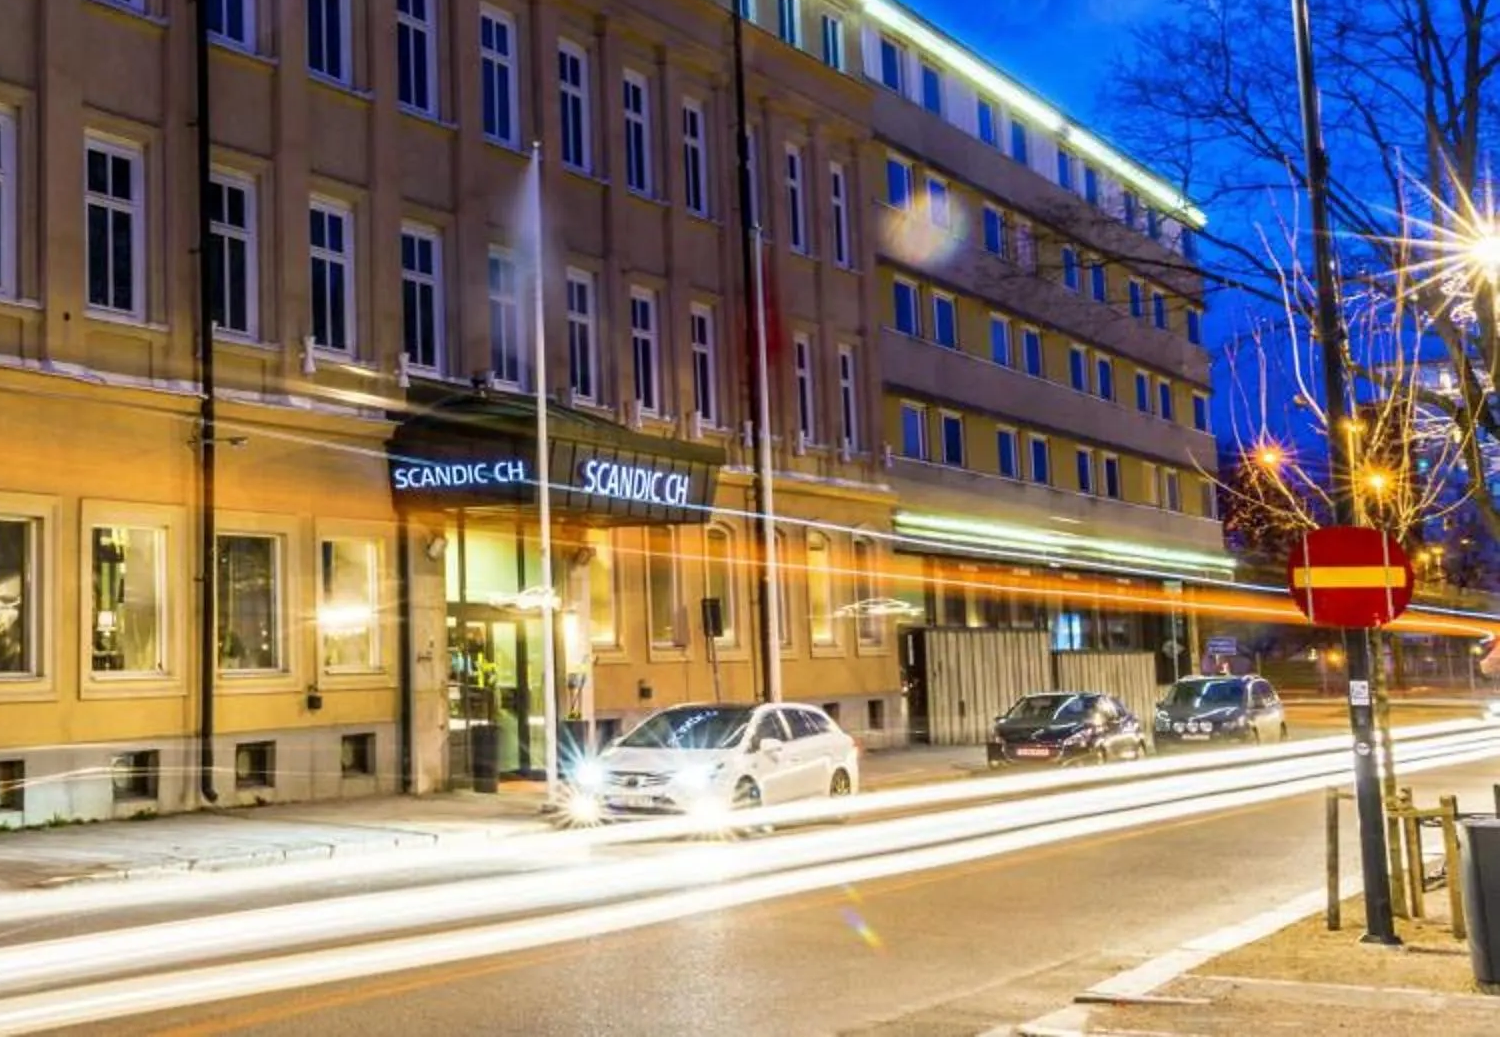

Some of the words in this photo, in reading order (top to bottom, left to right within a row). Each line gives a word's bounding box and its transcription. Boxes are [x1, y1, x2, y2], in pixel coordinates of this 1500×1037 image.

[394, 462, 488, 489] SCANDIC
[494, 460, 524, 483] CH
[584, 460, 662, 501] SCANDIC
[664, 473, 689, 505] CH
